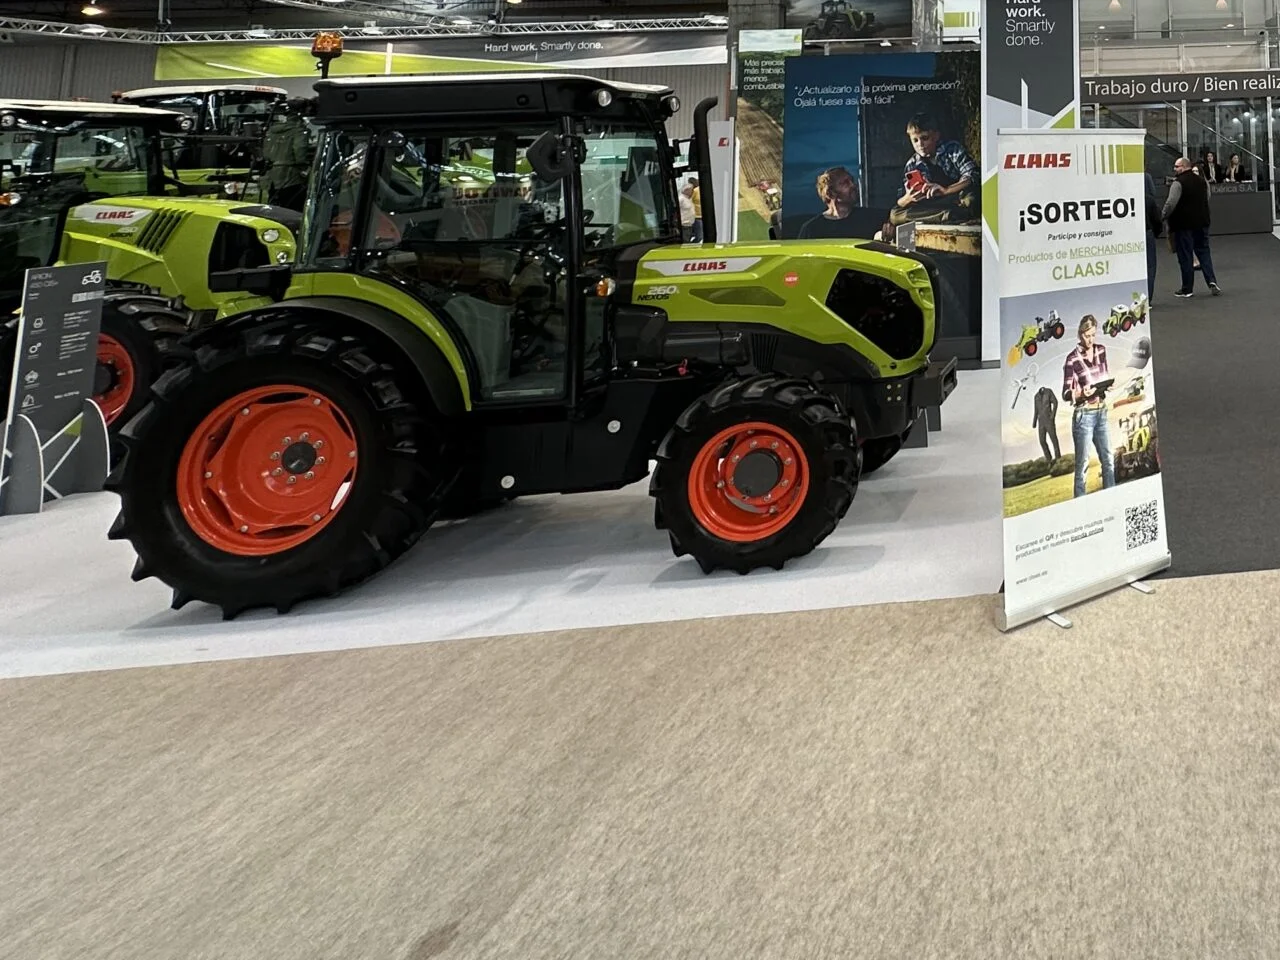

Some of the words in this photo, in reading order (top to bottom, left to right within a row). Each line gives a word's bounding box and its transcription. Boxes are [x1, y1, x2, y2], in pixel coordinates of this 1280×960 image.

[1006, 5, 1046, 17] work.
[1005, 19, 1056, 34] Smartly
[1005, 33, 1044, 46] done.
[484, 43, 509, 52] Hard
[511, 42, 538, 52] work.
[540, 41, 575, 52] Smartly
[577, 41, 604, 50] done.
[871, 83, 906, 93] próxima
[907, 80, 961, 93] generación?
[1085, 80, 1146, 98] Trabajo
[1150, 78, 1189, 93] duro
[1204, 76, 1238, 91] Bien
[794, 97, 817, 108] Ojalá
[818, 97, 843, 106] fuese
[859, 96, 872, 105] de
[1003, 153, 1072, 170] CLAAS
[95, 210, 136, 220] CLAAS
[1019, 197, 1136, 232] ¡SORTEO!
[1048, 231, 1077, 241] Participe
[1083, 229, 1113, 239] consigue
[1008, 251, 1054, 265] Productos
[1056, 249, 1068, 260] de
[682, 261, 728, 272] CLAAS
[1052, 261, 1110, 281] CLAAS!
[1045, 534, 1055, 542] QR
